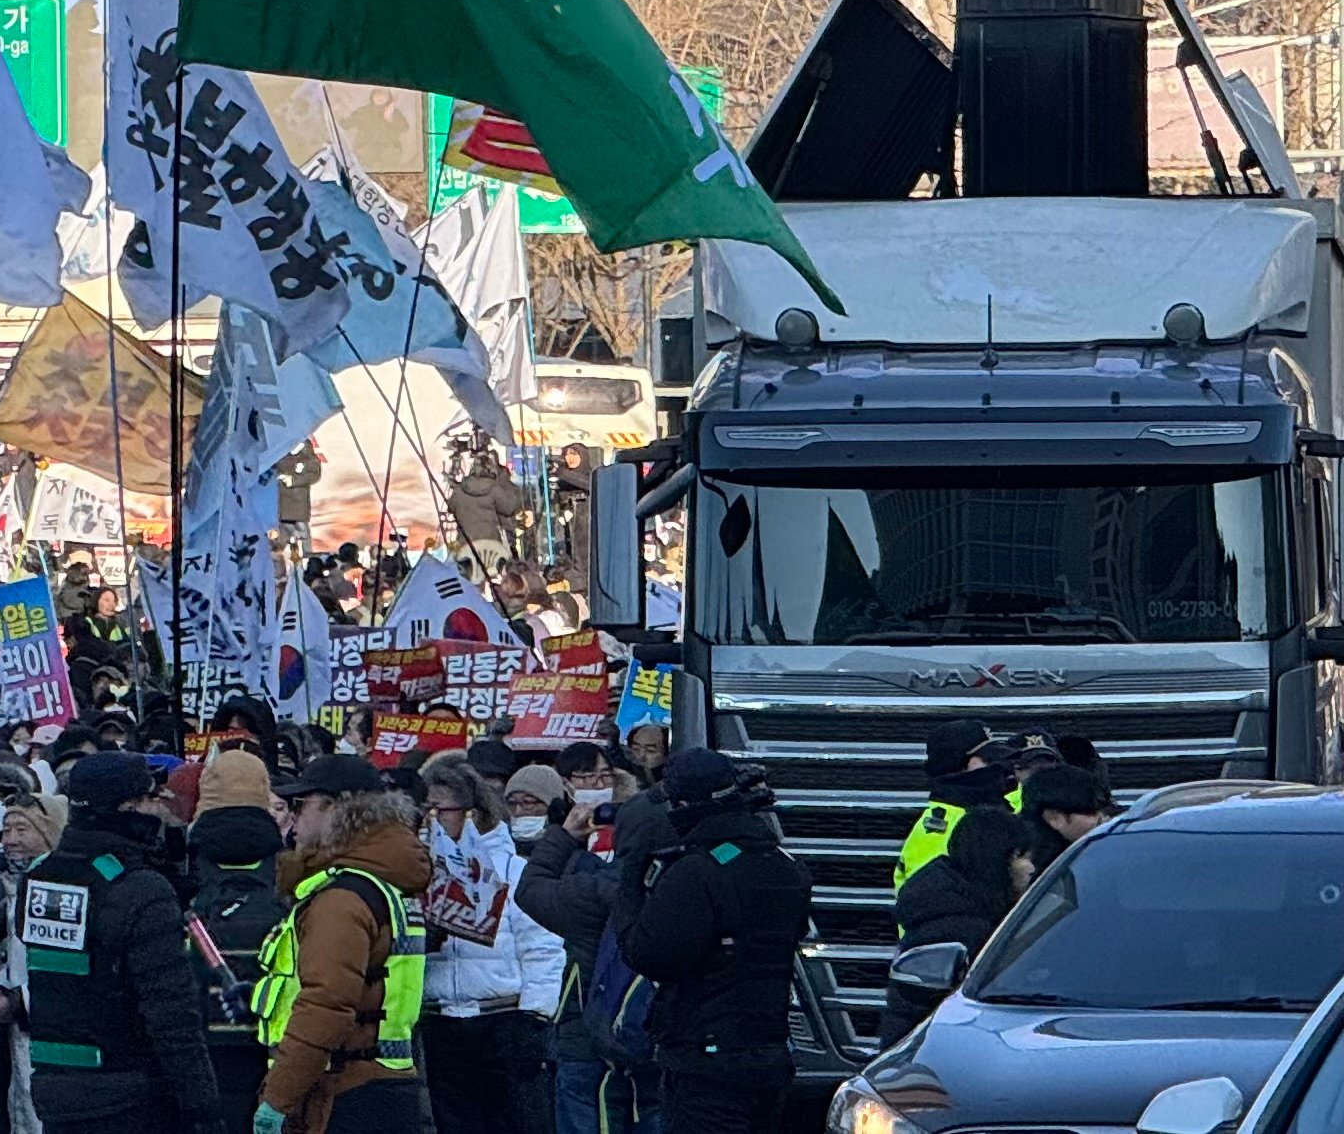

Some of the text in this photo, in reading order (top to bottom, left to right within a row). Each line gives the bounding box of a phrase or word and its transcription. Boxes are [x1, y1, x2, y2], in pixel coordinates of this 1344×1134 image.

[441, 647, 525, 685] 란동조
[911, 664, 1068, 689] MAXEN
[29, 922, 79, 944] POLICE
